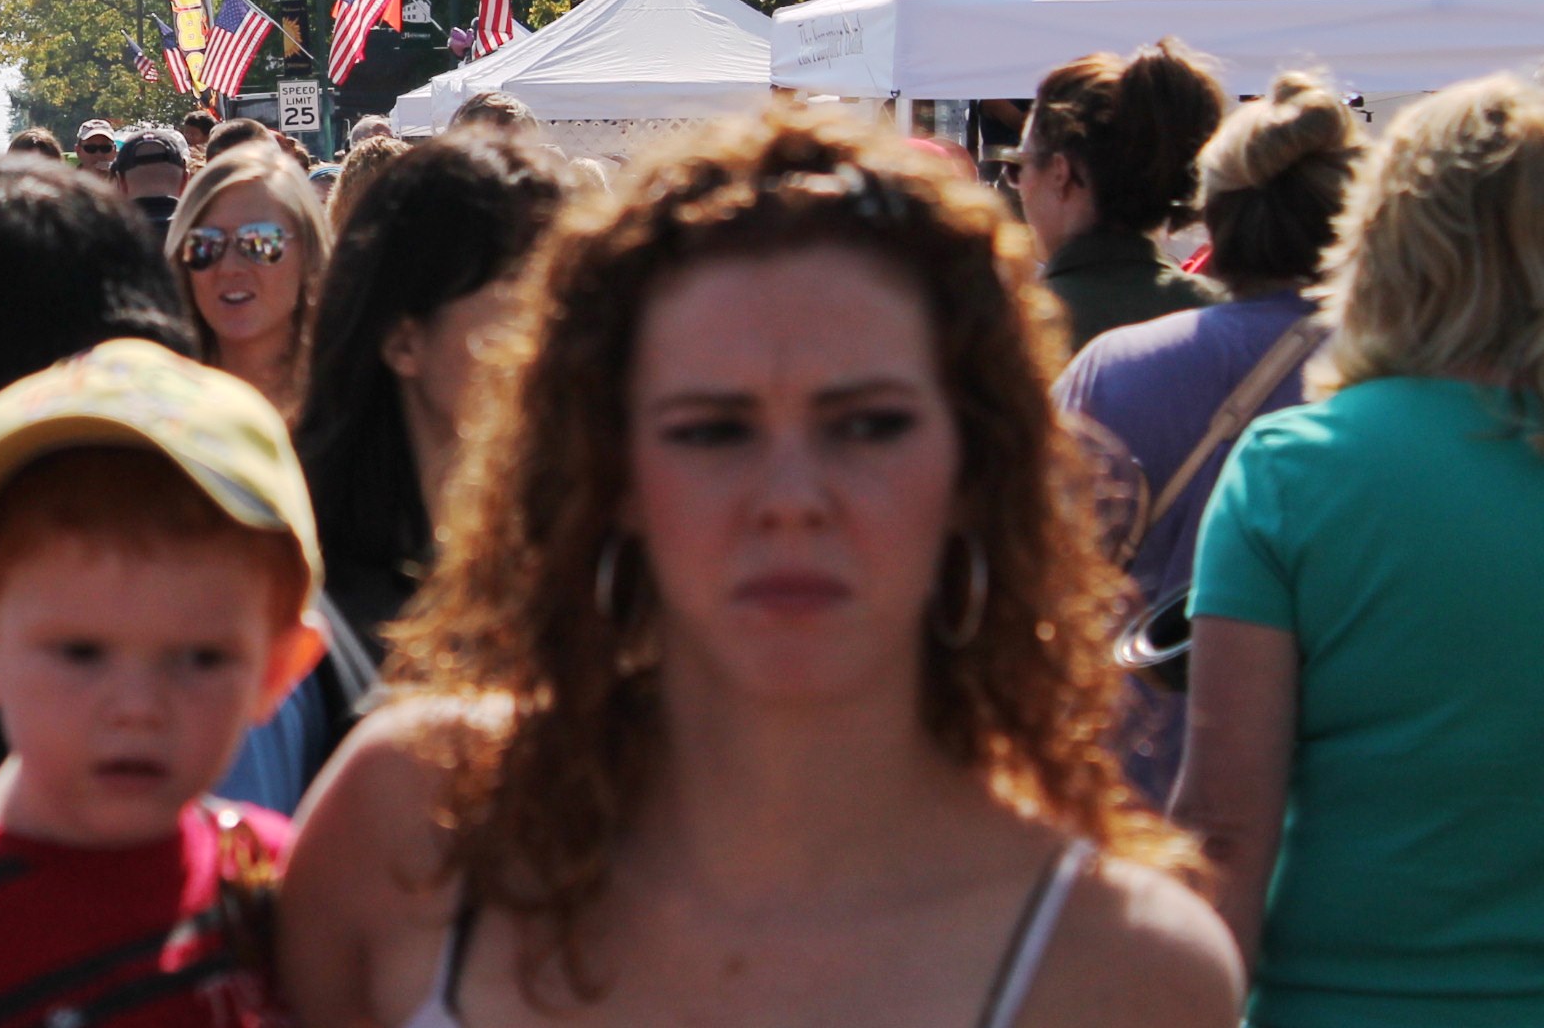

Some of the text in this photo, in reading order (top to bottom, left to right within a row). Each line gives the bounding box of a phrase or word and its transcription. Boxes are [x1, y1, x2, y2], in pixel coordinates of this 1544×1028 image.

[282, 86, 316, 95] SPEED
[286, 97, 312, 105] LIMIT
[284, 107, 315, 125] 25
